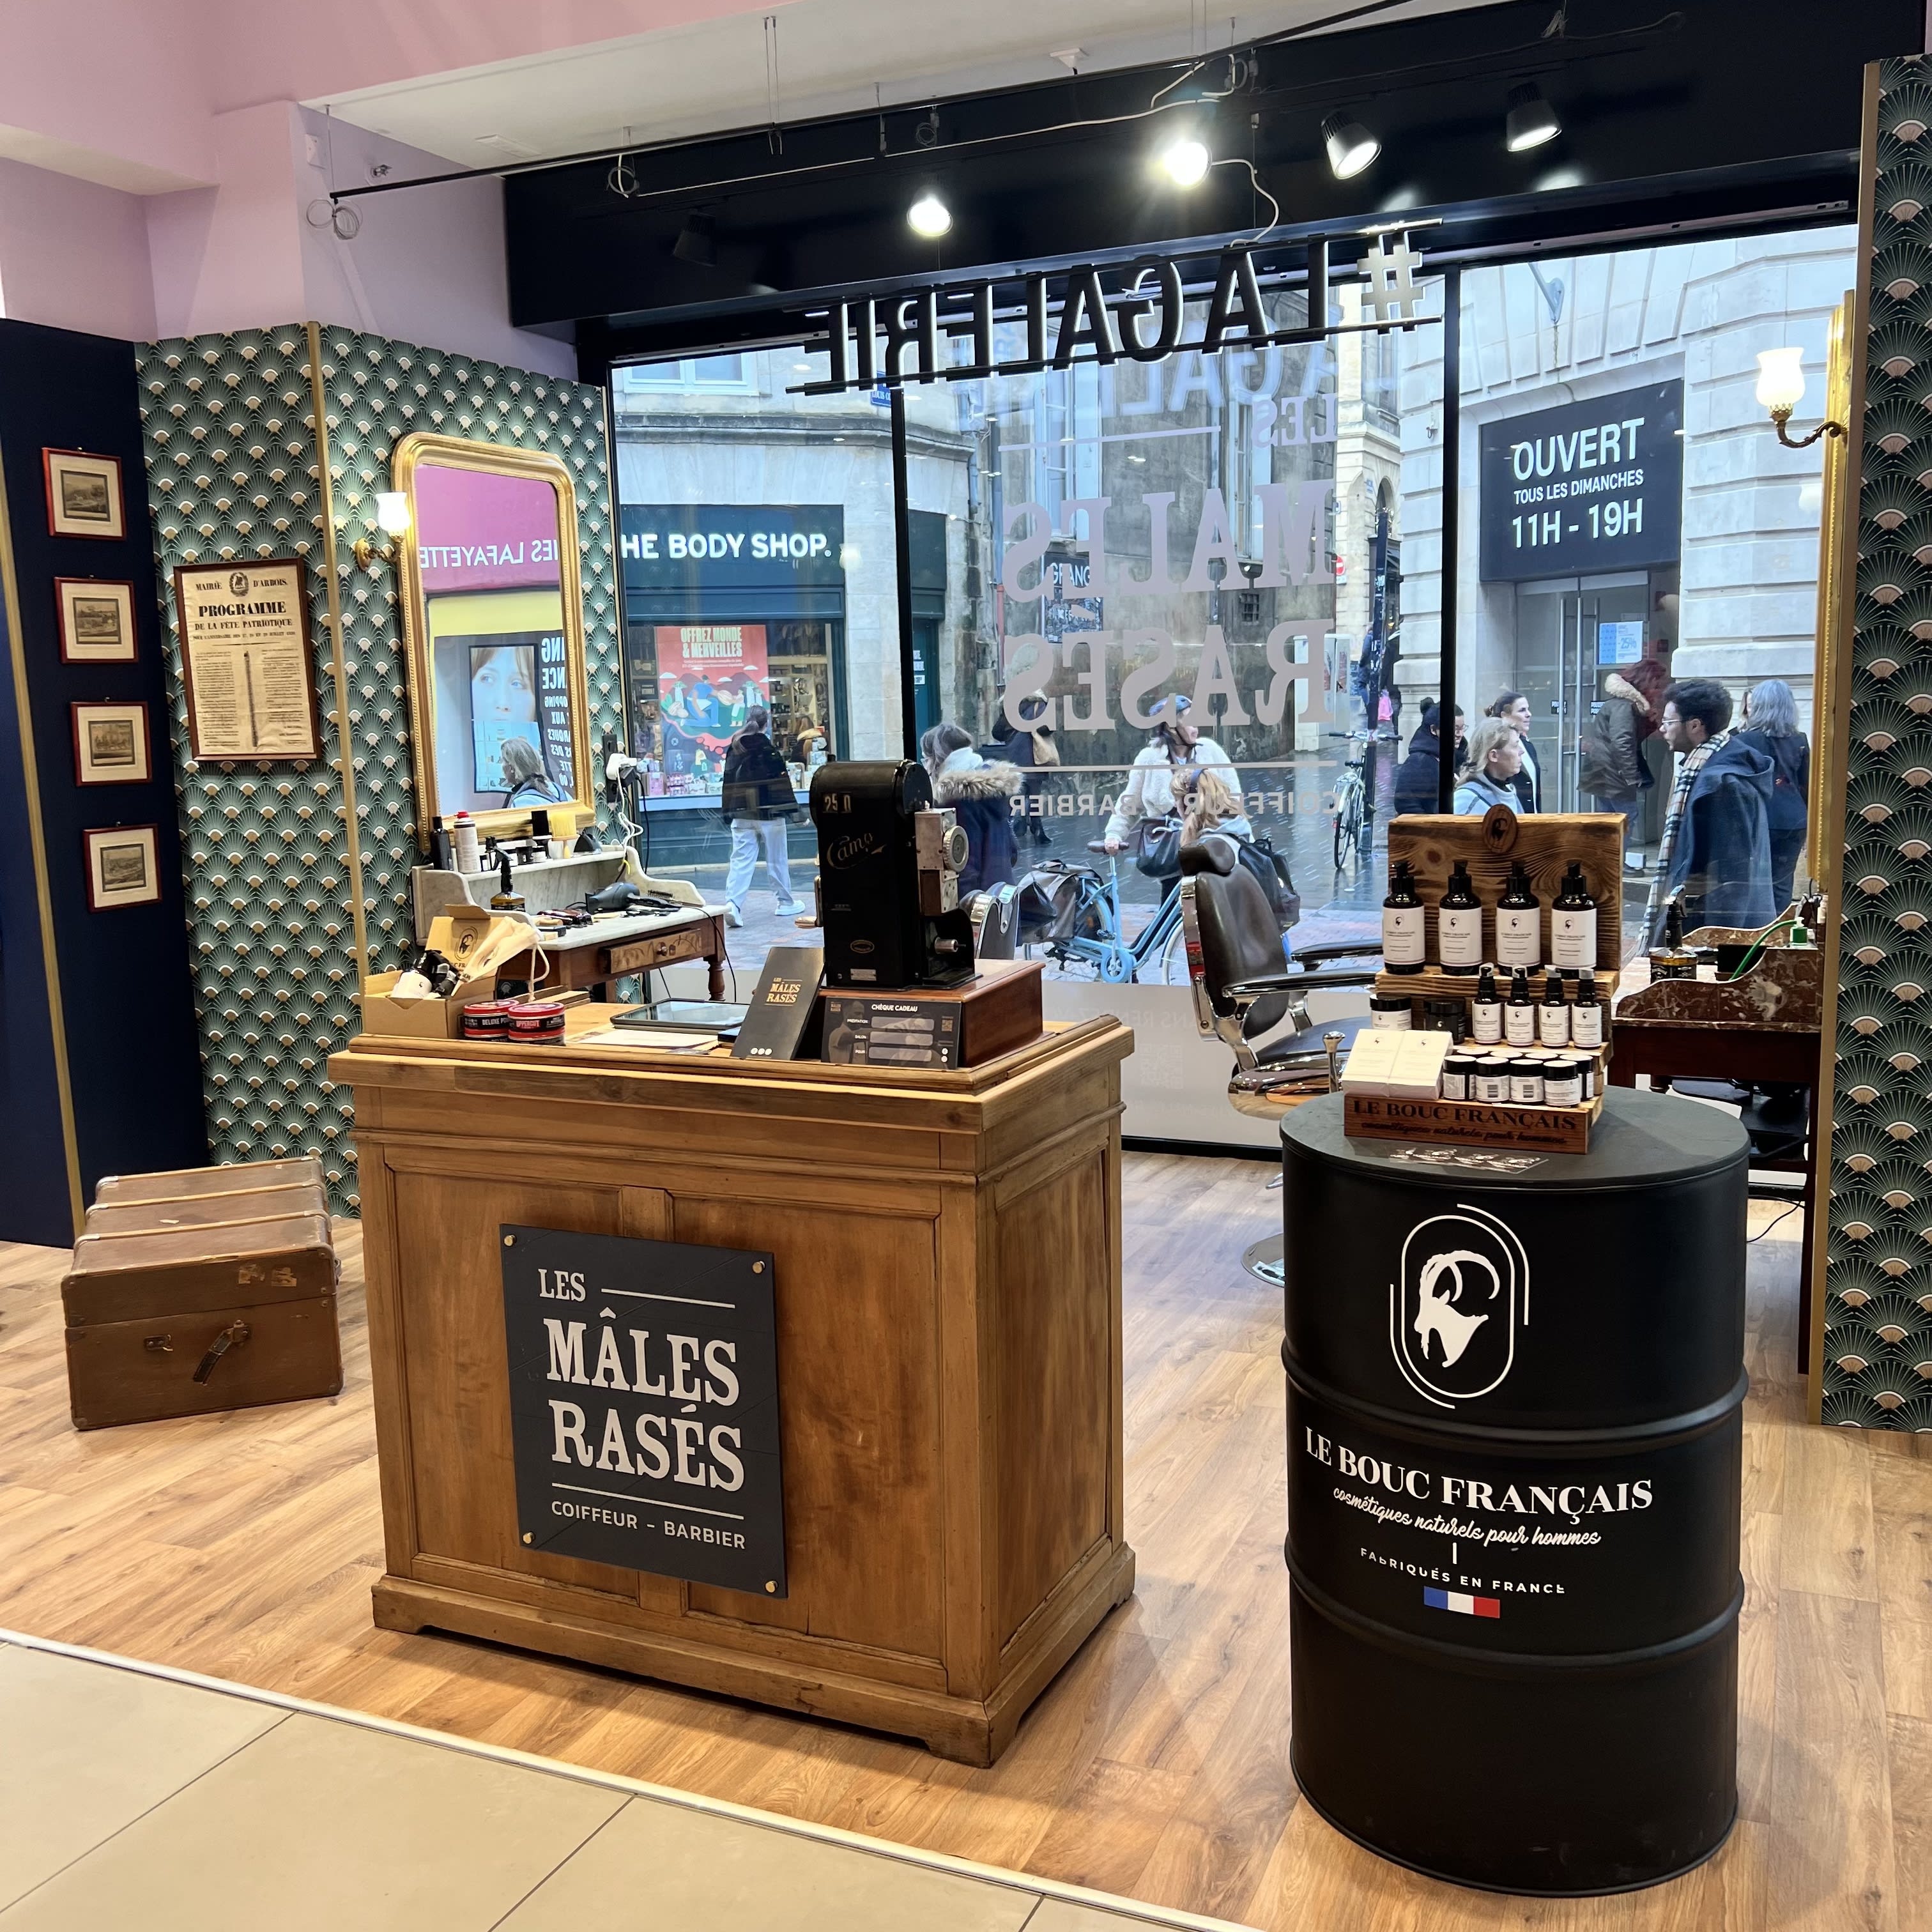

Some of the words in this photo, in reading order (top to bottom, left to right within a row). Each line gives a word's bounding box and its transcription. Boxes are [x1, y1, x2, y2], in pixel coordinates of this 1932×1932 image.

[1514, 417, 1644, 480] OUVERT
[1514, 486, 1544, 505] TOUS
[1547, 482, 1568, 500] LES
[1571, 469, 1644, 496] DIMANCHES
[1512, 510, 1561, 548] 11H
[1589, 498, 1643, 539] 19H
[621, 534, 659, 558] HE
[668, 533, 745, 558] BODY
[199, 601, 287, 617] PROGRAMME
[243, 618, 293, 629] PATRIOTIQUE
[680, 627, 712, 643] OFFREZ
[712, 627, 742, 642] MONDE
[682, 643, 690, 658] &
[691, 642, 742, 658] MERVEILLES
[1353, 1100, 1379, 1114] LE
[1386, 1103, 1448, 1121] BOUC
[1454, 1108, 1576, 1130] FRANÇAIS
[1483, 1130, 1514, 1142] pour
[537, 1268, 586, 1303] LES
[543, 1307, 740, 1407] MÂLES
[548, 1399, 745, 1492] RASÉS
[1306, 1425, 1331, 1466] LE
[1338, 1445, 1430, 1499] BOUC
[1441, 1476, 1653, 1524] FRANÇAIS
[551, 1500, 638, 1529] COIFFEUR
[663, 1521, 746, 1549] BARBIER
[1333, 1487, 1413, 1524] cosmétiques
[1414, 1509, 1484, 1540] naturels
[1483, 1525, 1529, 1547] pour
[1531, 1528, 1602, 1545] hommes
[1360, 1547, 1450, 1582] FABRIQUÉS
[1460, 1575, 1482, 1588] EN
[1492, 1581, 1565, 1593] FRANCE
